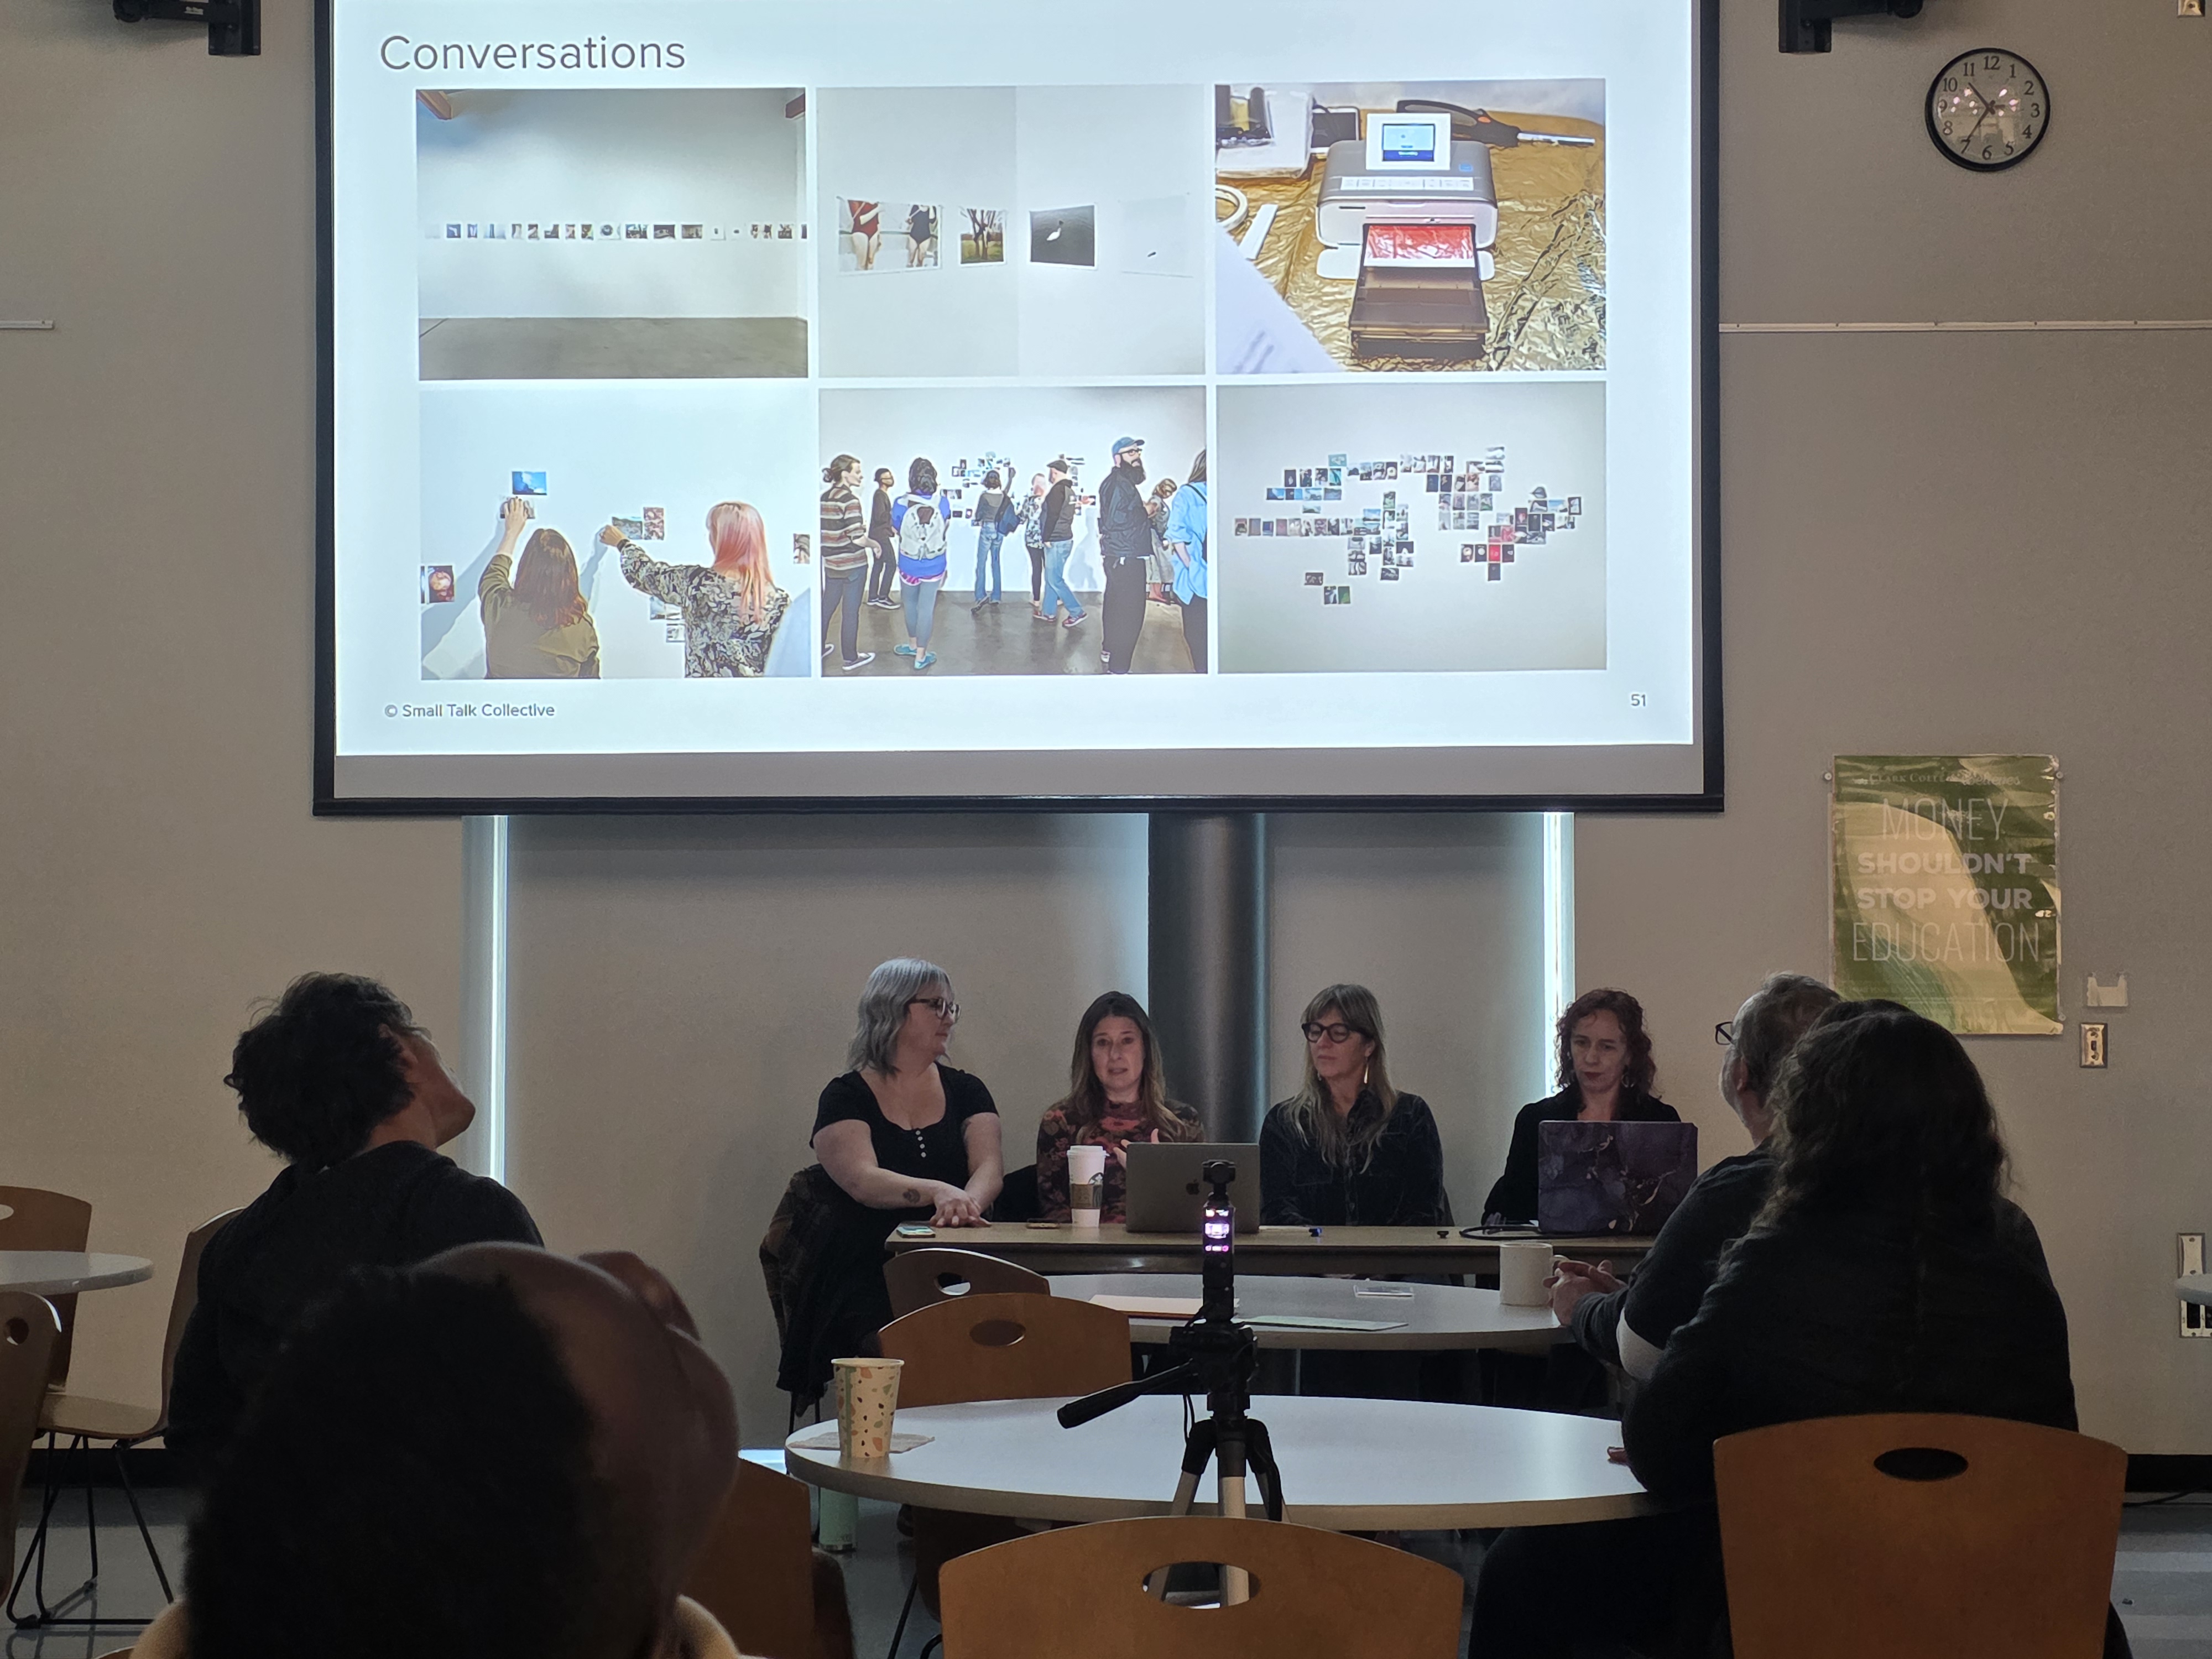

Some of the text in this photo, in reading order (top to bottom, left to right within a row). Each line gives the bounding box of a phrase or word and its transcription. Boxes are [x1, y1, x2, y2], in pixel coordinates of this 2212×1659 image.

[381, 35, 685, 70] Conversations
[1963, 62, 1975, 77] 11
[1983, 56, 2001, 70] 12
[2010, 64, 2017, 79] 1
[1943, 77, 1958, 92] 10
[2024, 80, 2034, 95] 2
[1938, 99, 1948, 112] 9
[2031, 103, 2041, 118] 3
[1943, 121, 1953, 135] 8
[2022, 124, 2032, 138] 4
[1961, 139, 1971, 154] 7
[1982, 145, 1992, 160] 6
[2004, 141, 2015, 156] 5
[1631, 693, 1646, 707] 51
[403, 704, 442, 717] Small
[447, 703, 477, 717] Talk
[482, 703, 555, 717] Collective
[1882, 797, 2009, 841] MONEY
[1857, 852, 2033, 874] SHOULDN'T
[1857, 888, 2033, 910] STOP YOUR
[1853, 921, 2039, 963] EDUCATION
